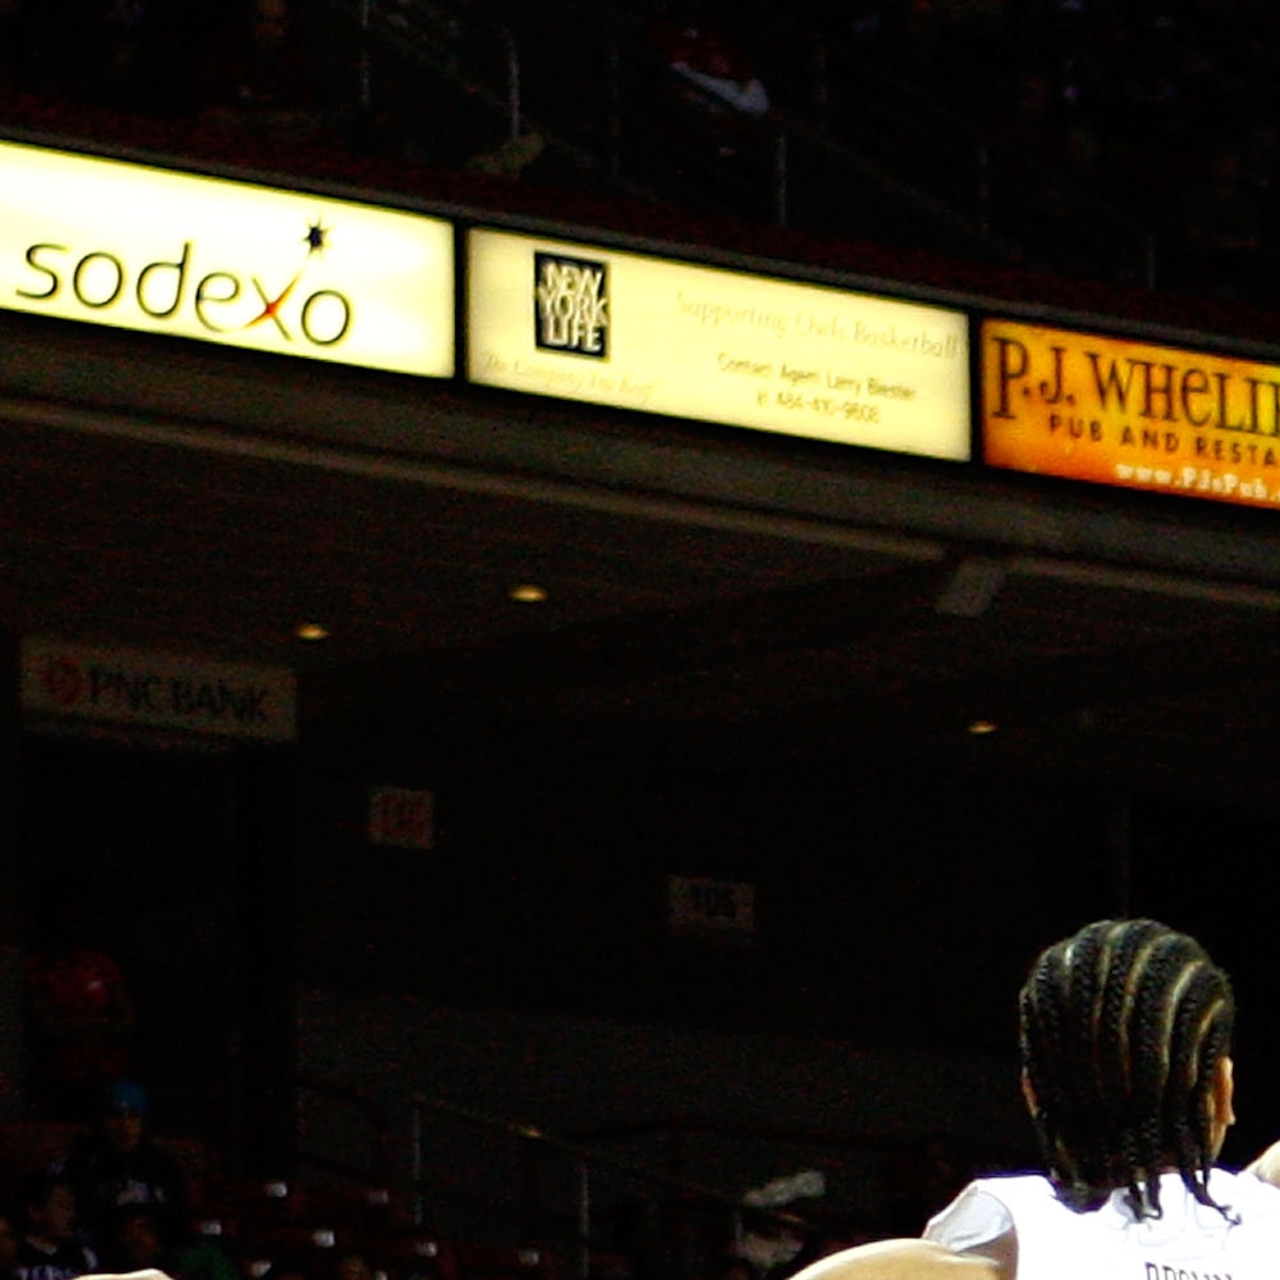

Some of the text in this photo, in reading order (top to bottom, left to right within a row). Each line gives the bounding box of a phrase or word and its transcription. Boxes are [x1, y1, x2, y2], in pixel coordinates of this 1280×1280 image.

[15, 241, 351, 346] sodexo
[546, 264, 601, 299] NEW
[539, 287, 608, 327] YORK
[547, 315, 600, 351] LIFE
[1050, 414, 1102, 442] PUB
[1120, 426, 1179, 453] AND
